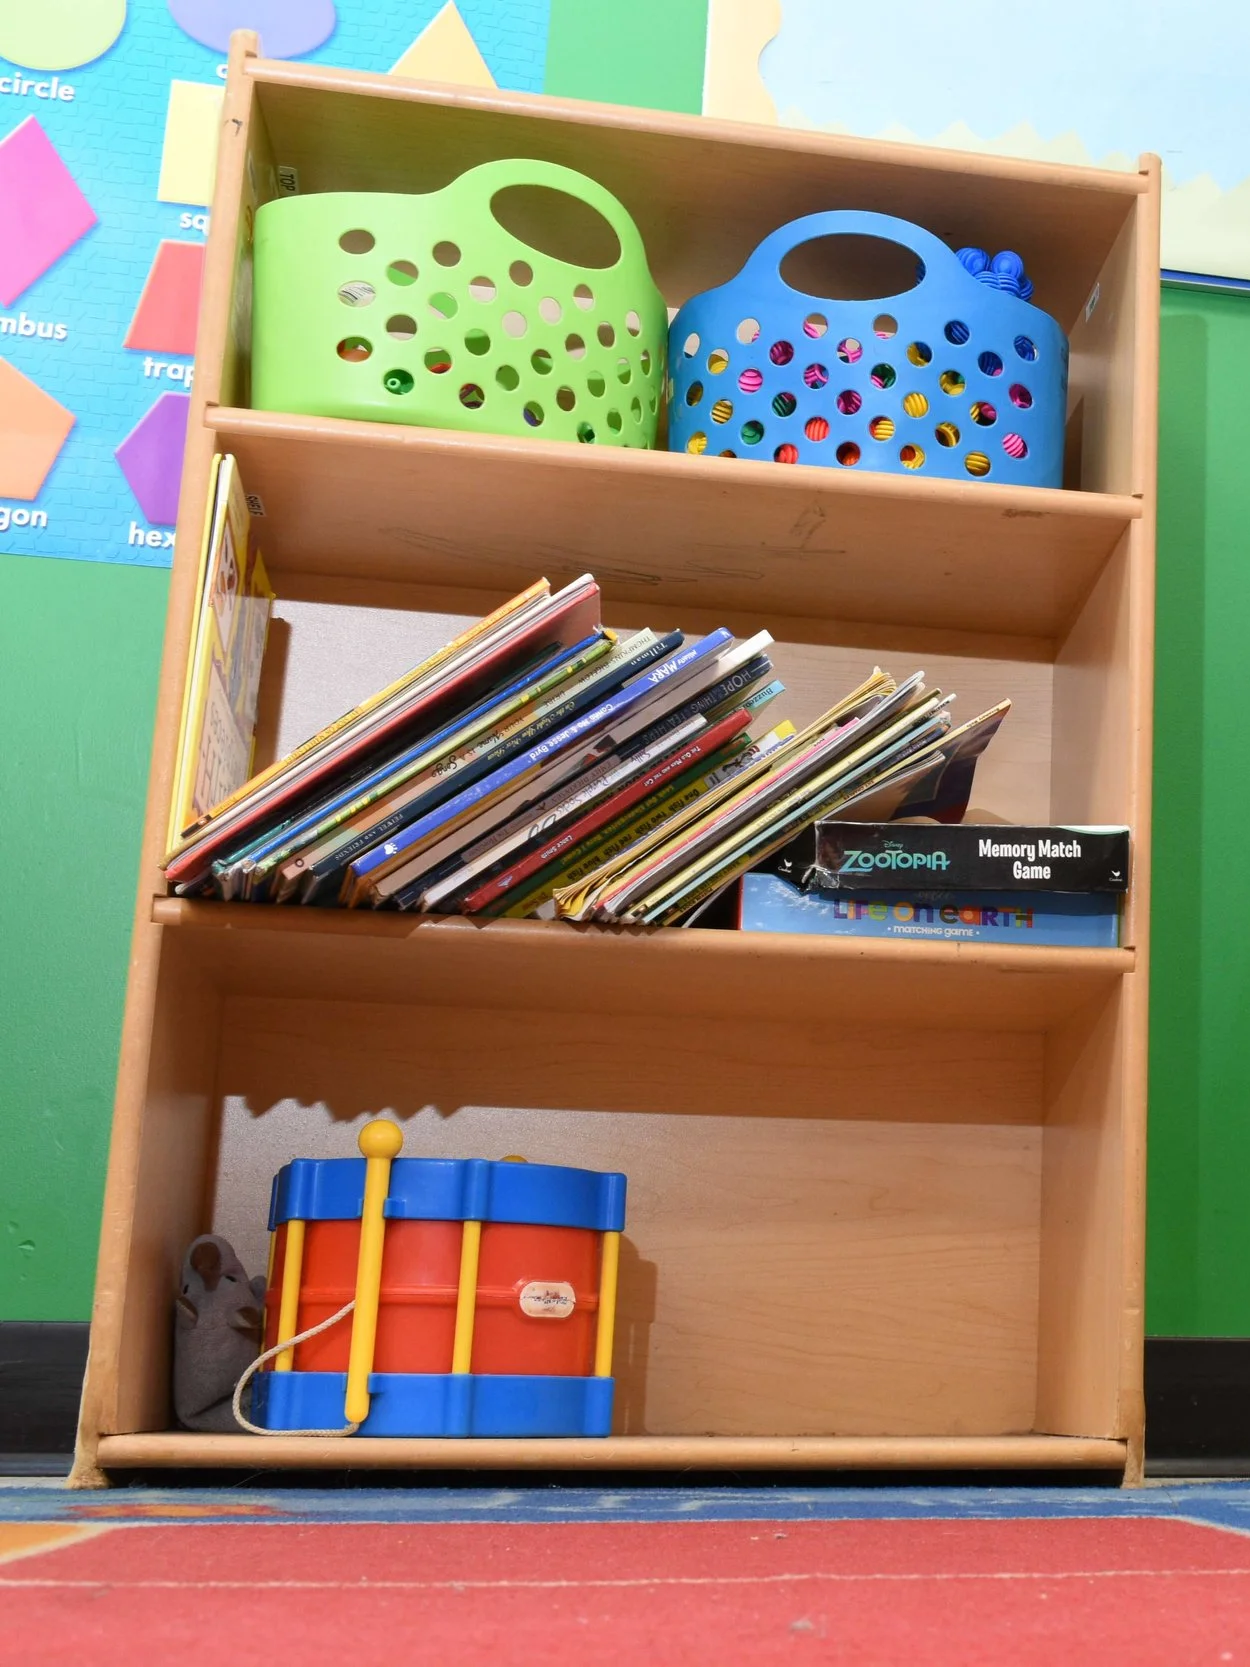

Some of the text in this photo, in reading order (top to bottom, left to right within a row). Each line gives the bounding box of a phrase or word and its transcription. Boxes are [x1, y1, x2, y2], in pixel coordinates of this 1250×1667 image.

[0, 72, 75, 101] circle
[280, 173, 295, 191] TOP
[645, 658, 679, 685] MARA
[718, 668, 753, 696] HOPE
[689, 692, 717, 715] THING
[527, 743, 549, 760] Byrd
[681, 787, 700, 803] One
[666, 797, 685, 813] fish
[648, 809, 667, 825] two
[632, 819, 652, 836] fish
[601, 841, 620, 857] fish
[881, 840, 904, 849] Disney
[978, 839, 1082, 862] Memory Match
[580, 853, 601, 871] blue
[1012, 861, 1052, 880] Game
[564, 865, 584, 882] fish
